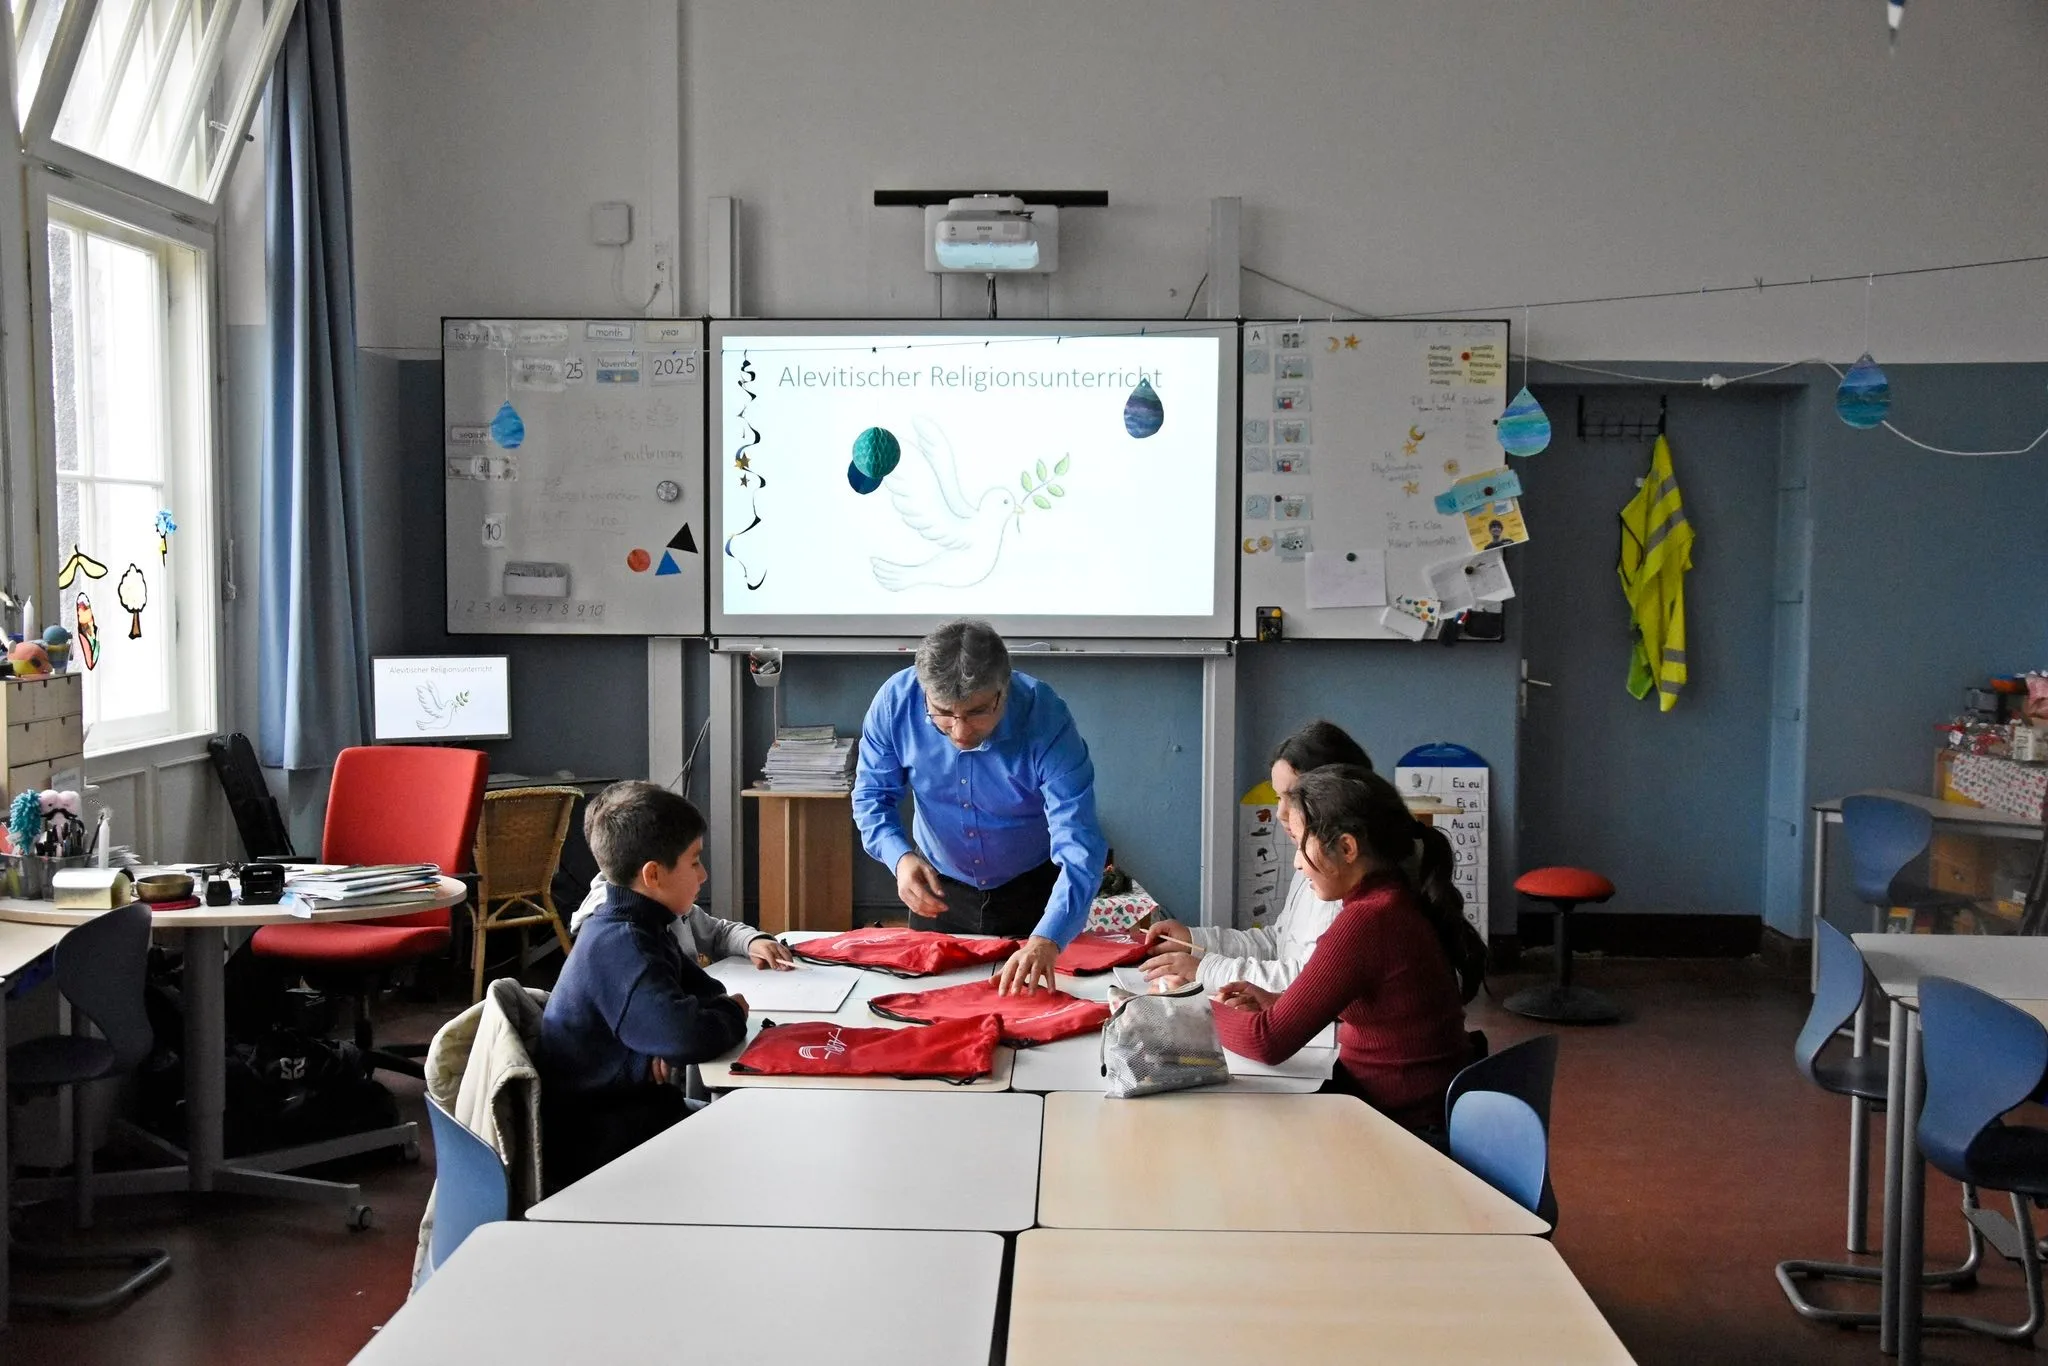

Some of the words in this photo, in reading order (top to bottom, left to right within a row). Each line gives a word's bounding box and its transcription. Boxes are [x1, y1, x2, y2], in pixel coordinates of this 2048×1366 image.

[595, 327, 624, 337] month
[660, 328, 679, 340] year
[1252, 330, 1261, 341] A
[597, 358, 639, 368] November
[654, 357, 696, 376] 2025
[565, 362, 584, 380] 25
[778, 366, 922, 389] Alevitischer
[931, 366, 1164, 392] Religionsunterricht
[484, 522, 502, 541] 10
[466, 601, 475, 613] 2
[482, 602, 491, 613] 3
[498, 602, 507, 612] 4
[514, 602, 523, 613] 5
[529, 603, 538, 615] 6
[545, 603, 553, 615] 7
[561, 603, 569, 615] 8
[576, 603, 585, 616] 9
[589, 604, 603, 616] 10
[389, 666, 429, 674] Alevitischer
[1452, 777, 1465, 788] Eu
[1468, 780, 1480, 789] eu
[1456, 798, 1466, 808] Ei
[1469, 799, 1478, 809] ei
[1451, 818, 1464, 829] Au
[1467, 821, 1481, 829] au
